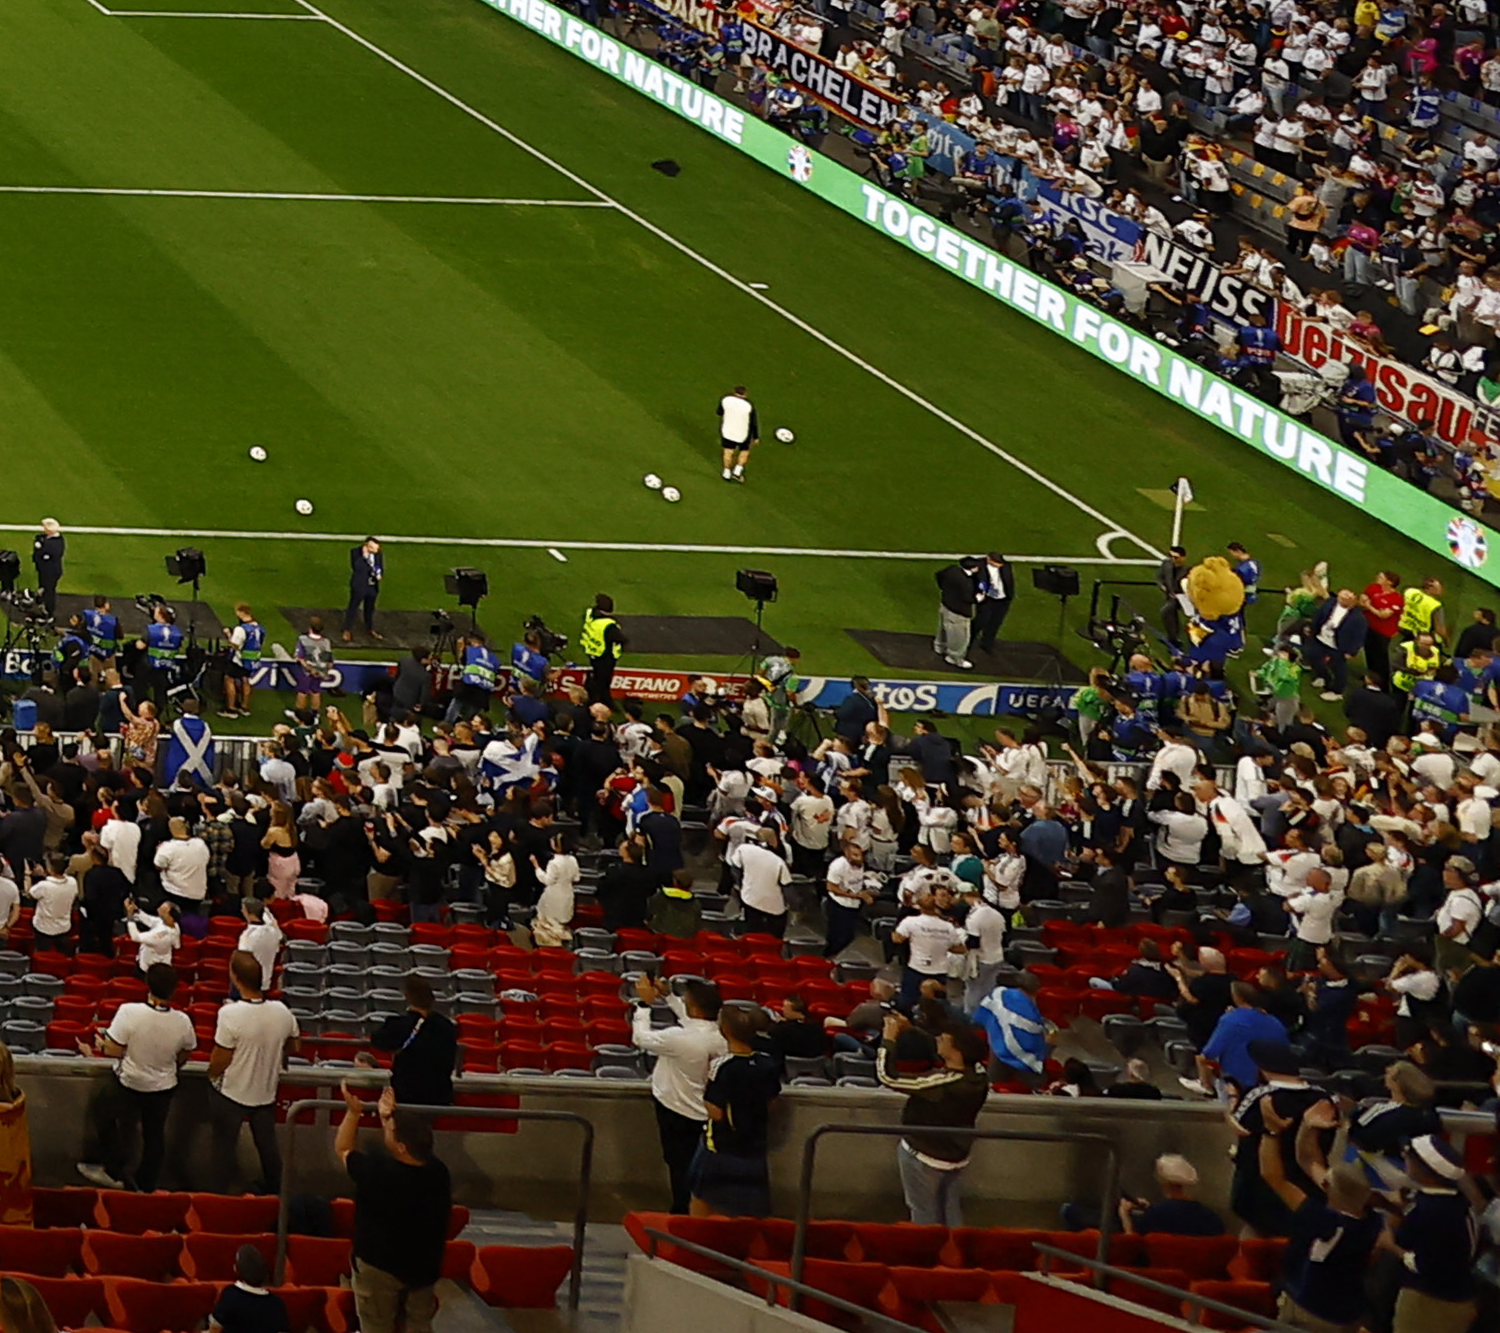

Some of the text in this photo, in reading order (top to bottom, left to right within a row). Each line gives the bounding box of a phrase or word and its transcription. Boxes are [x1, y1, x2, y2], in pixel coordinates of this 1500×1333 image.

[564, 18, 621, 75] FOR
[624, 51, 746, 145] NATURE
[1060, 189, 1122, 234] KSC
[862, 184, 1369, 503] TOGETHER FOR NATURE
[610, 675, 682, 693] BETANO
